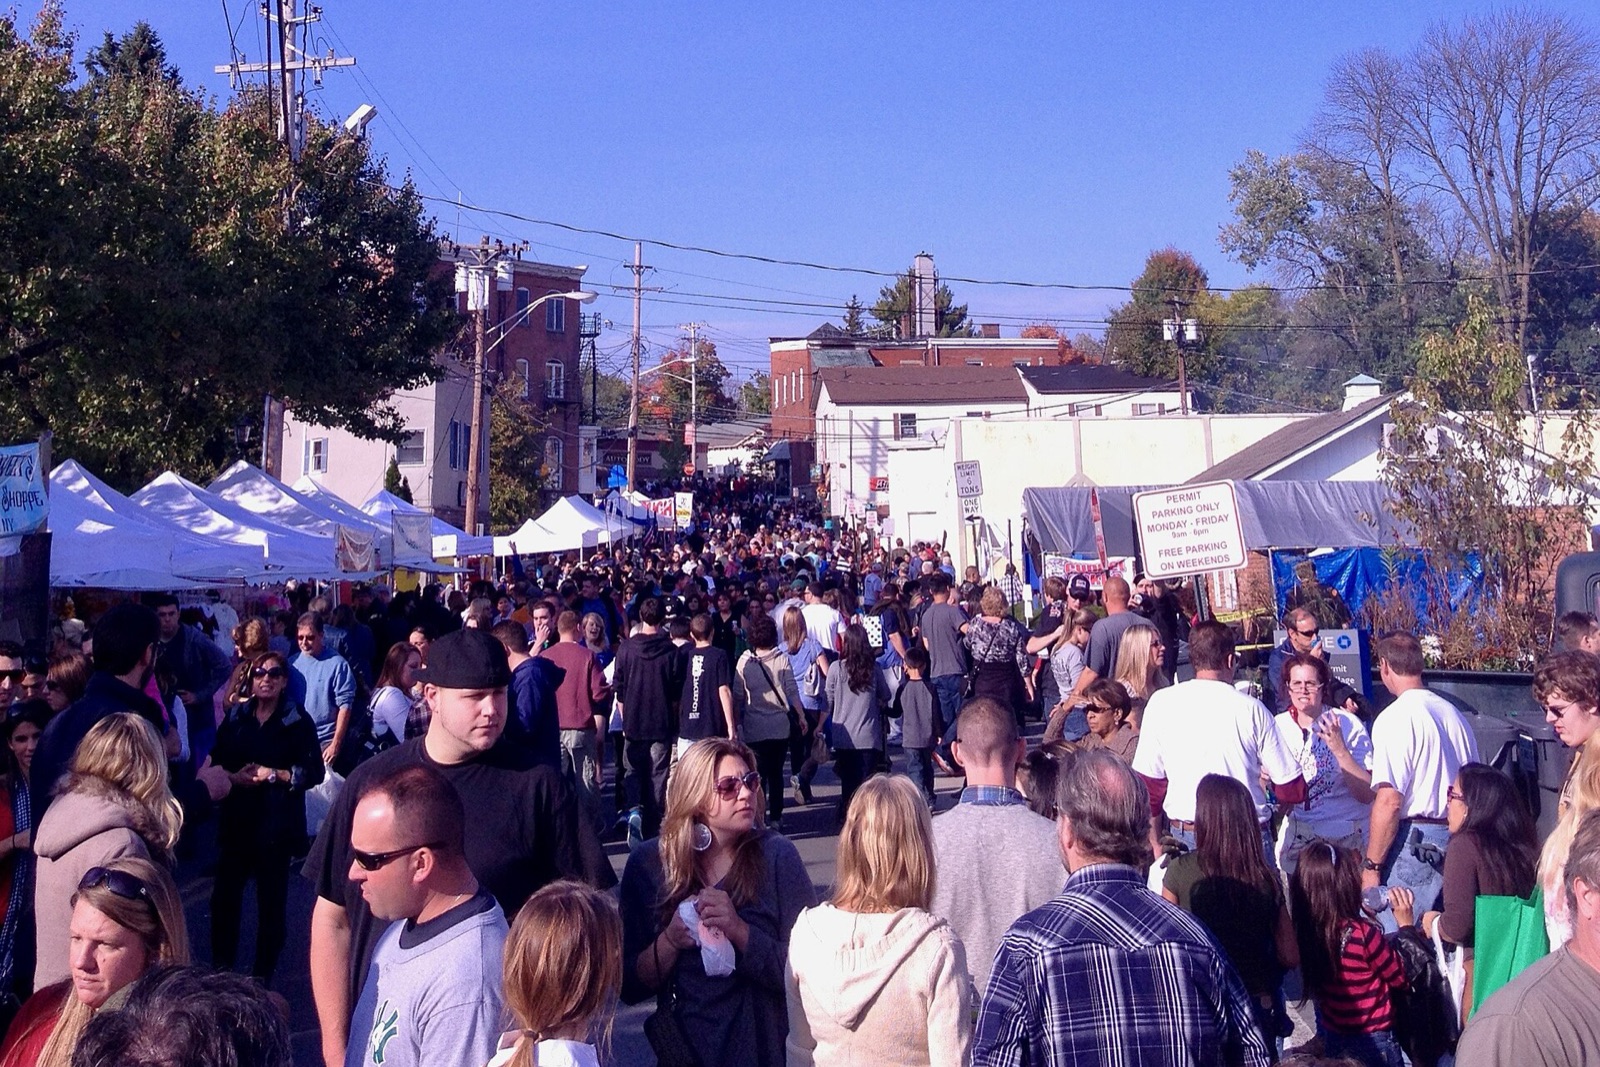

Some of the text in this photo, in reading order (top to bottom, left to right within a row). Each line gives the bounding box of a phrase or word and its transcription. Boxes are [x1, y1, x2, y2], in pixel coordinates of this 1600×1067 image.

[957, 463, 978, 471] WEIGHT
[960, 485, 980, 494] TONS
[2, 486, 44, 512] SHOPPE
[964, 498, 979, 506] ONE
[1166, 491, 1202, 504] PERMIT
[1151, 502, 1221, 519] PARKING ONLY
[1147, 520, 1188, 533] MONDAY
[1195, 514, 1230, 527] FRIDAY
[1171, 531, 1188, 539] 9am
[1193, 528, 1209, 537] 6pm
[1158, 541, 1228, 558] FREE PARKING
[1160, 554, 1231, 571] ON WEEKENDS
